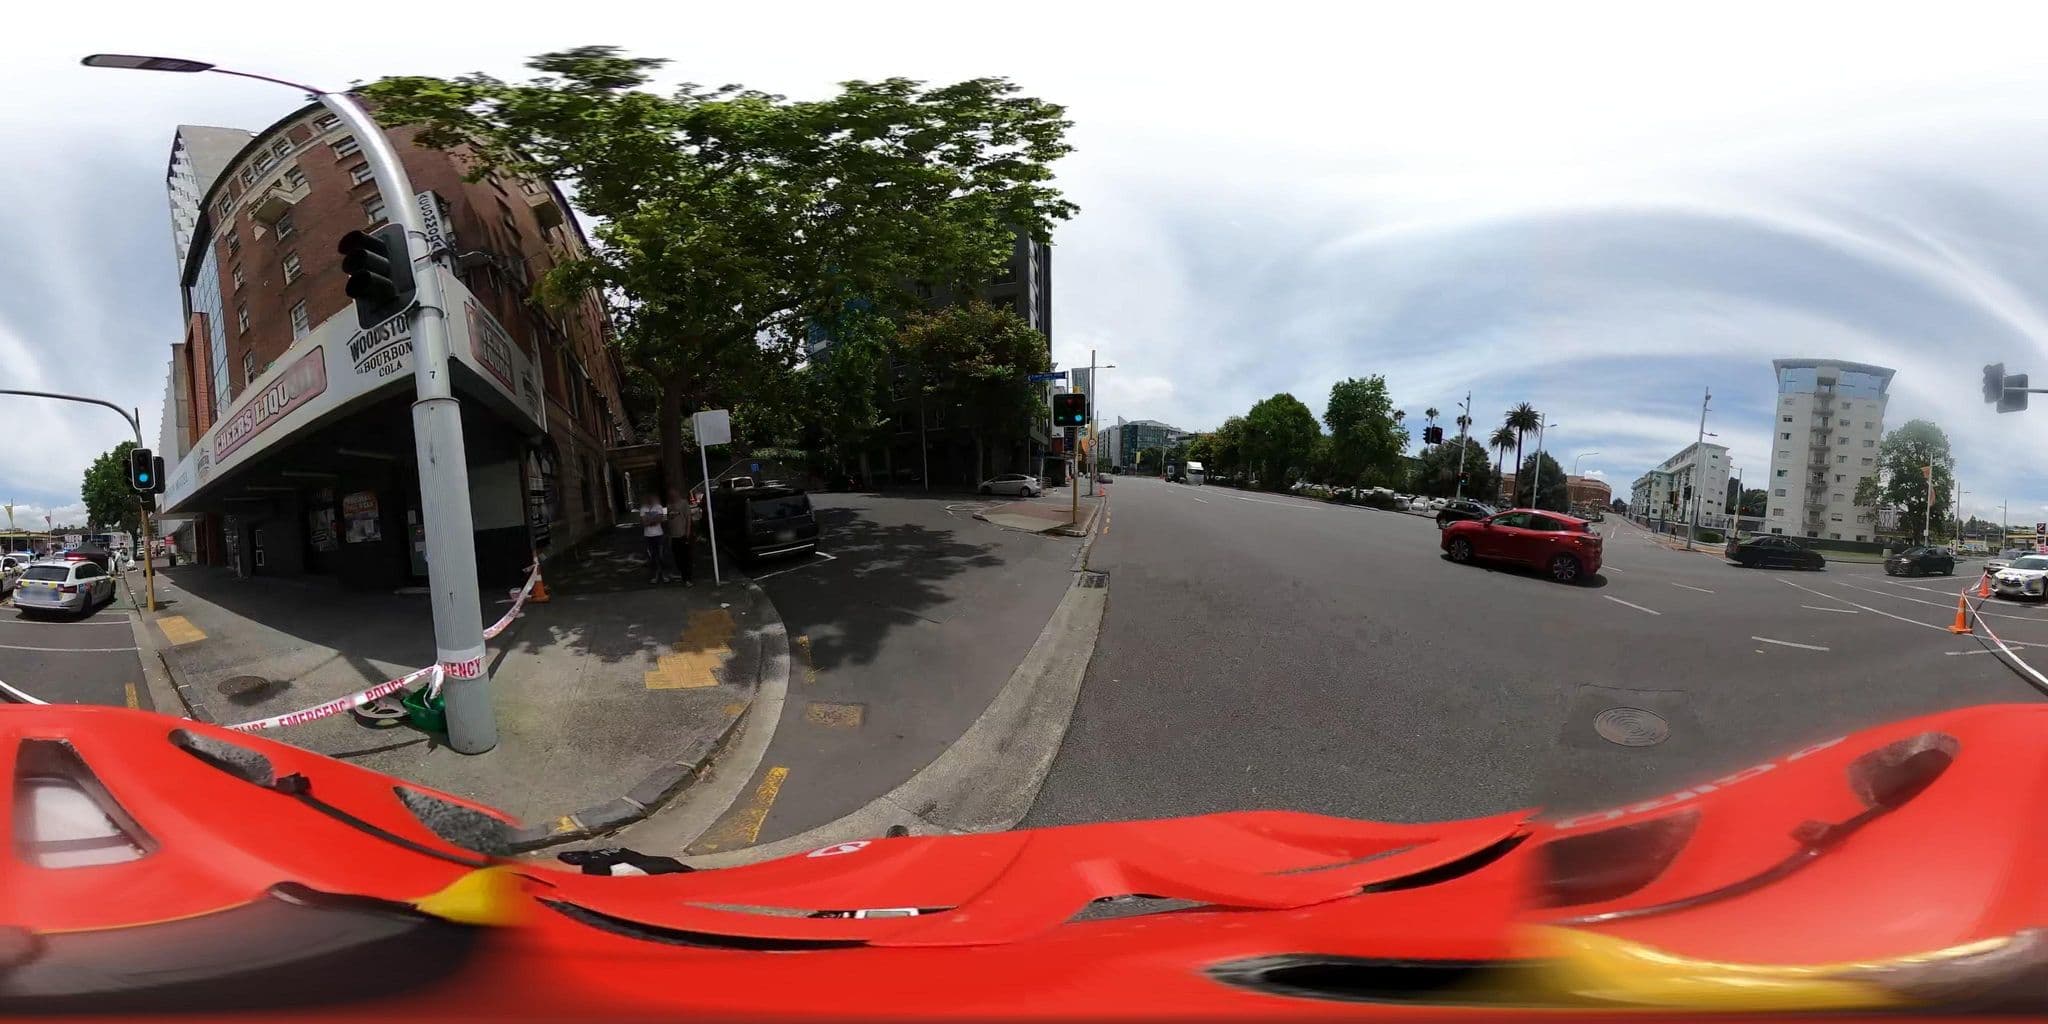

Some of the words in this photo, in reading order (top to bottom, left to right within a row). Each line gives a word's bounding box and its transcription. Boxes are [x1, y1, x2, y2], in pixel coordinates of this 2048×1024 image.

[350, 313, 411, 363] WOODSTO
[363, 341, 413, 373] BOURBON
[379, 360, 403, 377] COLA
[215, 408, 254, 457] CHEERS
[444, 658, 481, 679] GENCY
[279, 700, 349, 728] EMERGENC
